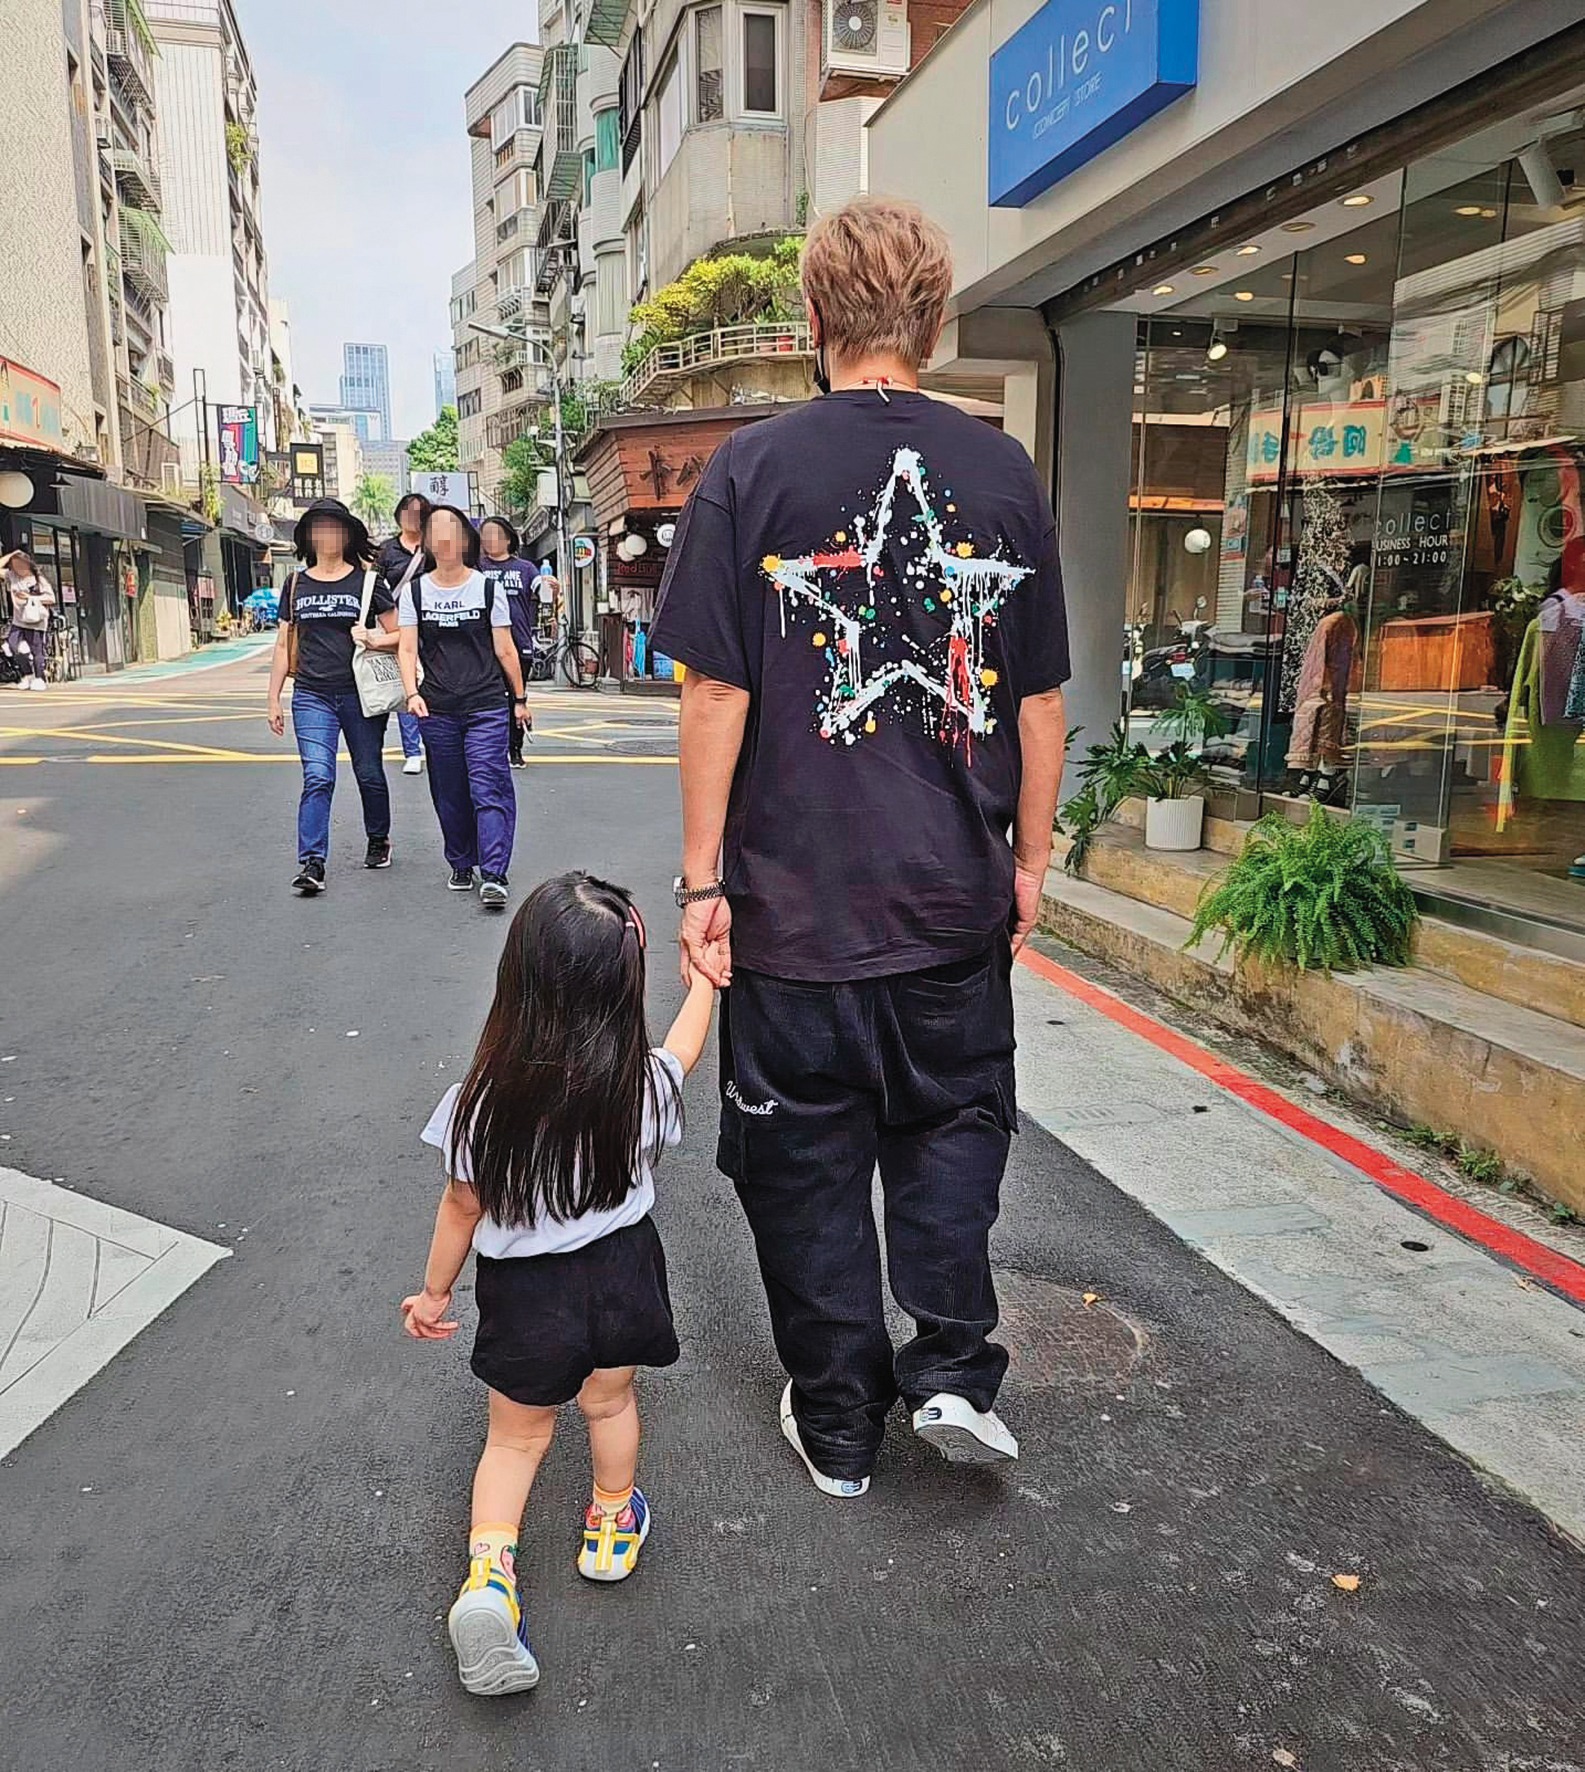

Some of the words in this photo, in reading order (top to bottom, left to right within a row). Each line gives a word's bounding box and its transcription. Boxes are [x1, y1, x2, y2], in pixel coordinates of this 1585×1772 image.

[1033, 96, 1071, 139] CONCEPT
[1074, 70, 1103, 108] STORE
[1375, 537, 1411, 552] USINESS
[296, 594, 361, 611] HOLLISTER
[434, 600, 465, 610] KARL
